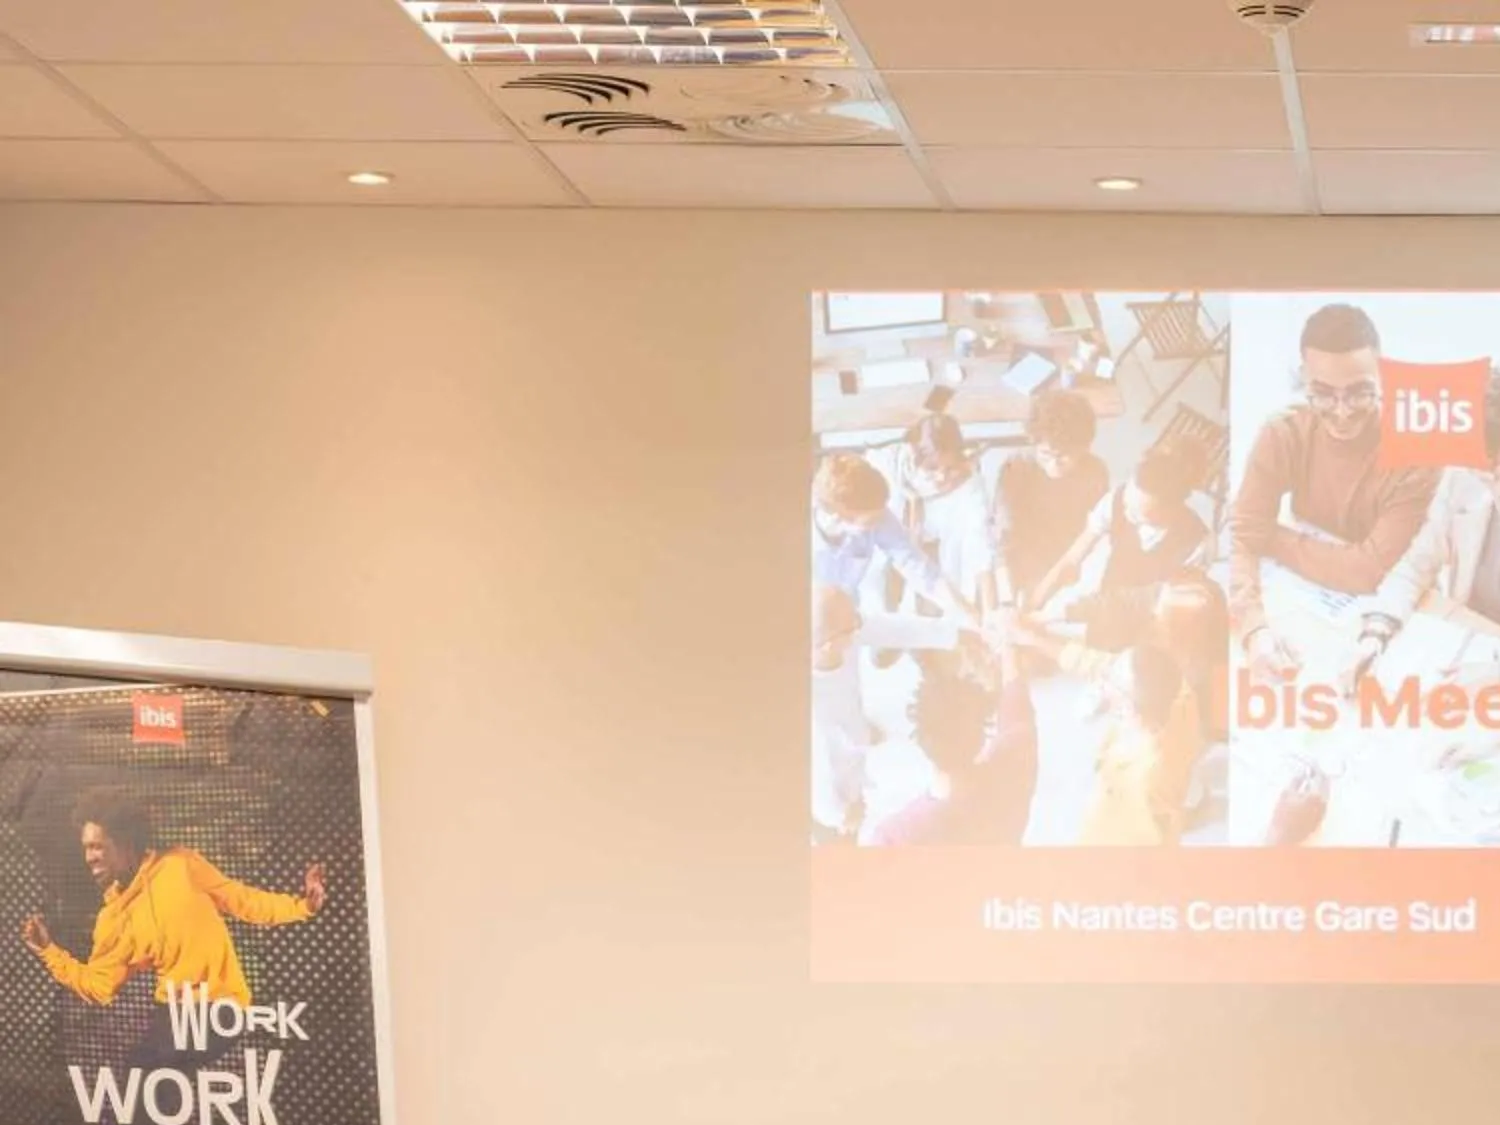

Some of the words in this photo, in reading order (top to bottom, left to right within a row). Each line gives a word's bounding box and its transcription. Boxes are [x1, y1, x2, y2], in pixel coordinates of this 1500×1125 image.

[1395, 389, 1474, 434] ibis
[139, 703, 177, 728] ibis
[983, 898, 1042, 931] Ibis
[1052, 899, 1178, 932] Nantes
[1186, 899, 1305, 932] Centre
[1314, 899, 1398, 932] Gare
[1408, 898, 1477, 931] Sud
[166, 980, 310, 1051] WORK
